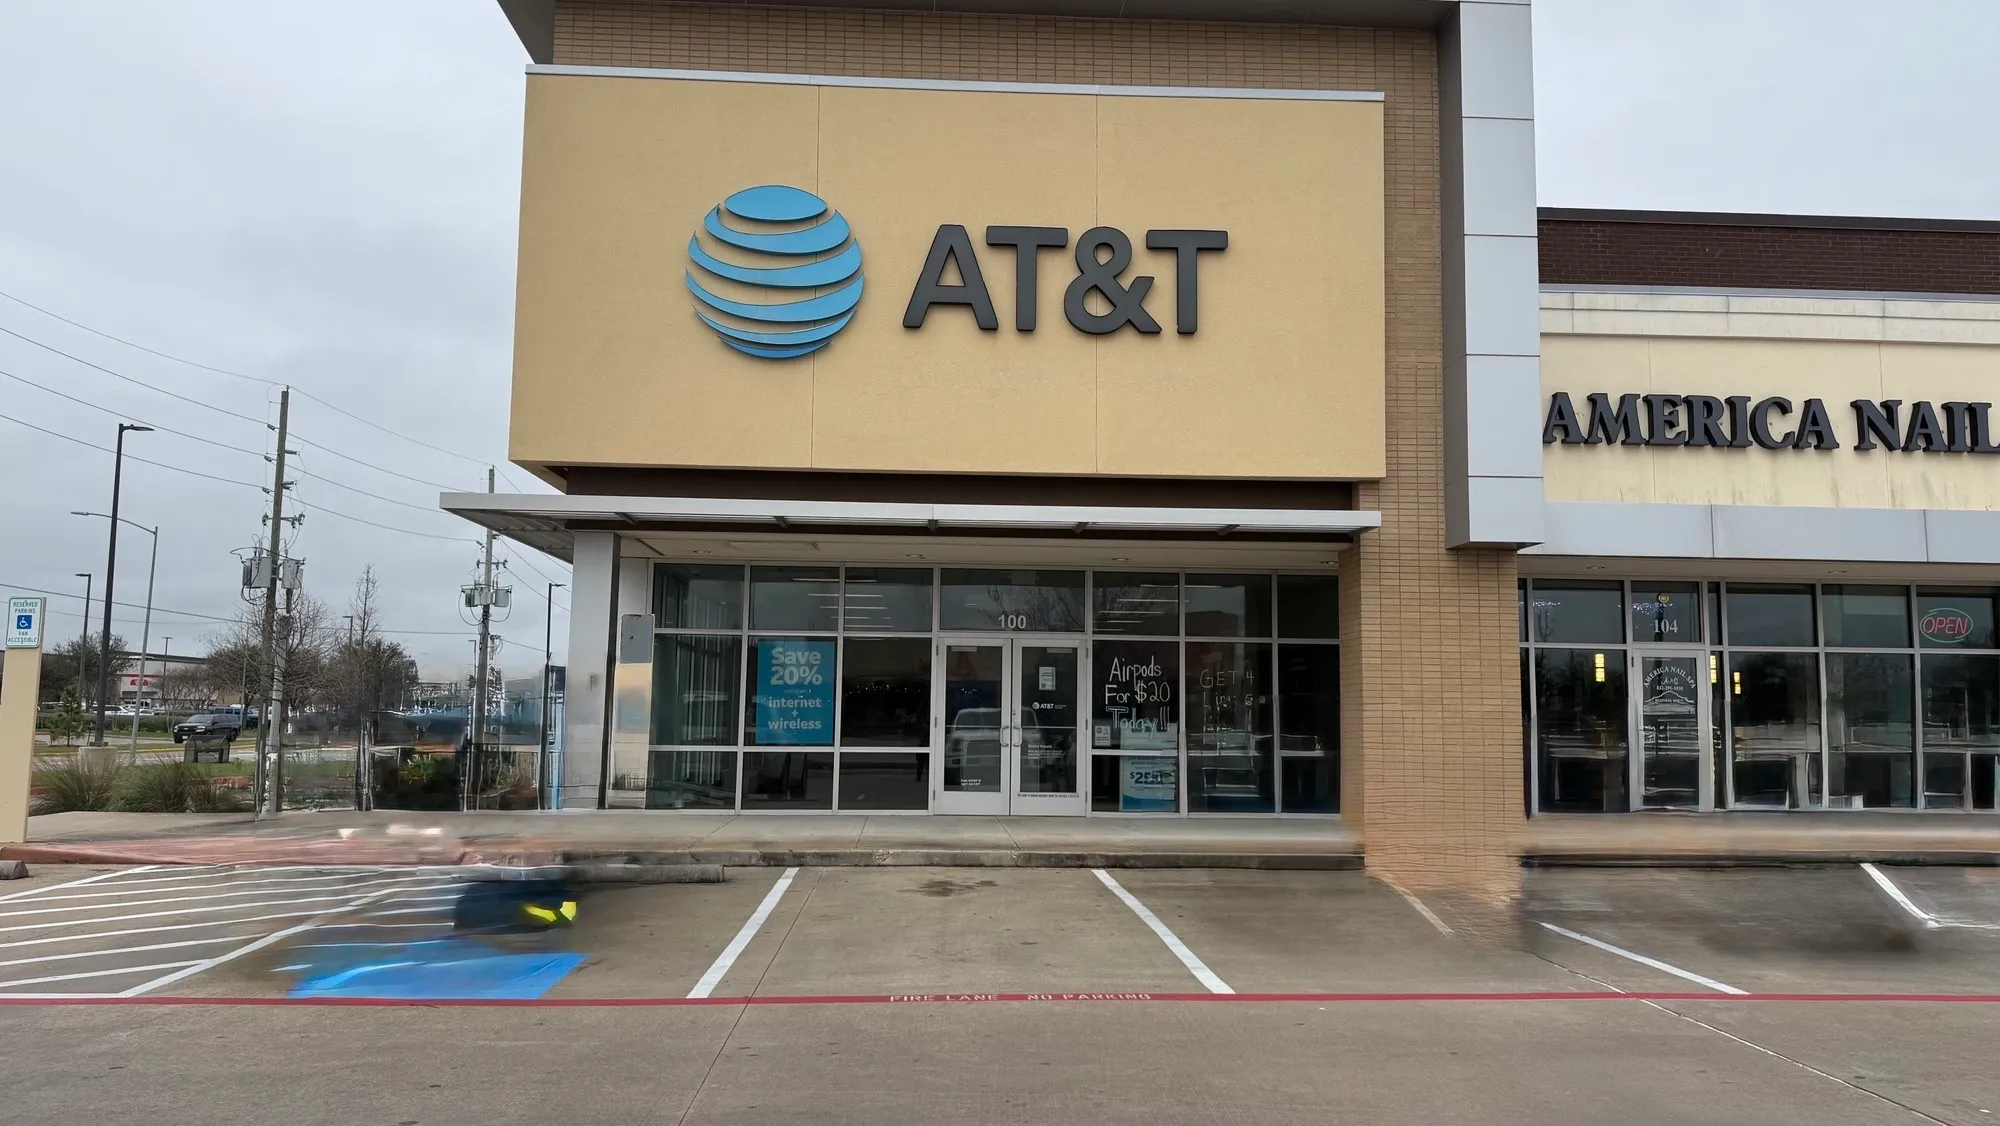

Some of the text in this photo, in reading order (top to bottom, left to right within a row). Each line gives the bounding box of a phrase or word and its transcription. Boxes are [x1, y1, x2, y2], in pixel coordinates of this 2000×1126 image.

[903, 224, 1228, 335] AT&T
[1543, 391, 2000, 454] AMERICA NAIL
[998, 615, 1027, 629] 100
[1653, 619, 1678, 633] 104
[1923, 617, 1968, 634] OPEN
[771, 647, 822, 665] Save
[770, 665, 823, 685] 20%
[1109, 655, 1162, 690] Airpods
[1200, 669, 1255, 688] GET 4
[1643, 665, 1669, 688] AMERICA
[1670, 666, 1686, 678] NAIL
[1685, 675, 1697, 689] SPA
[768, 696, 822, 708] internet
[1105, 680, 1171, 705] For $20
[767, 717, 822, 729] wireless
